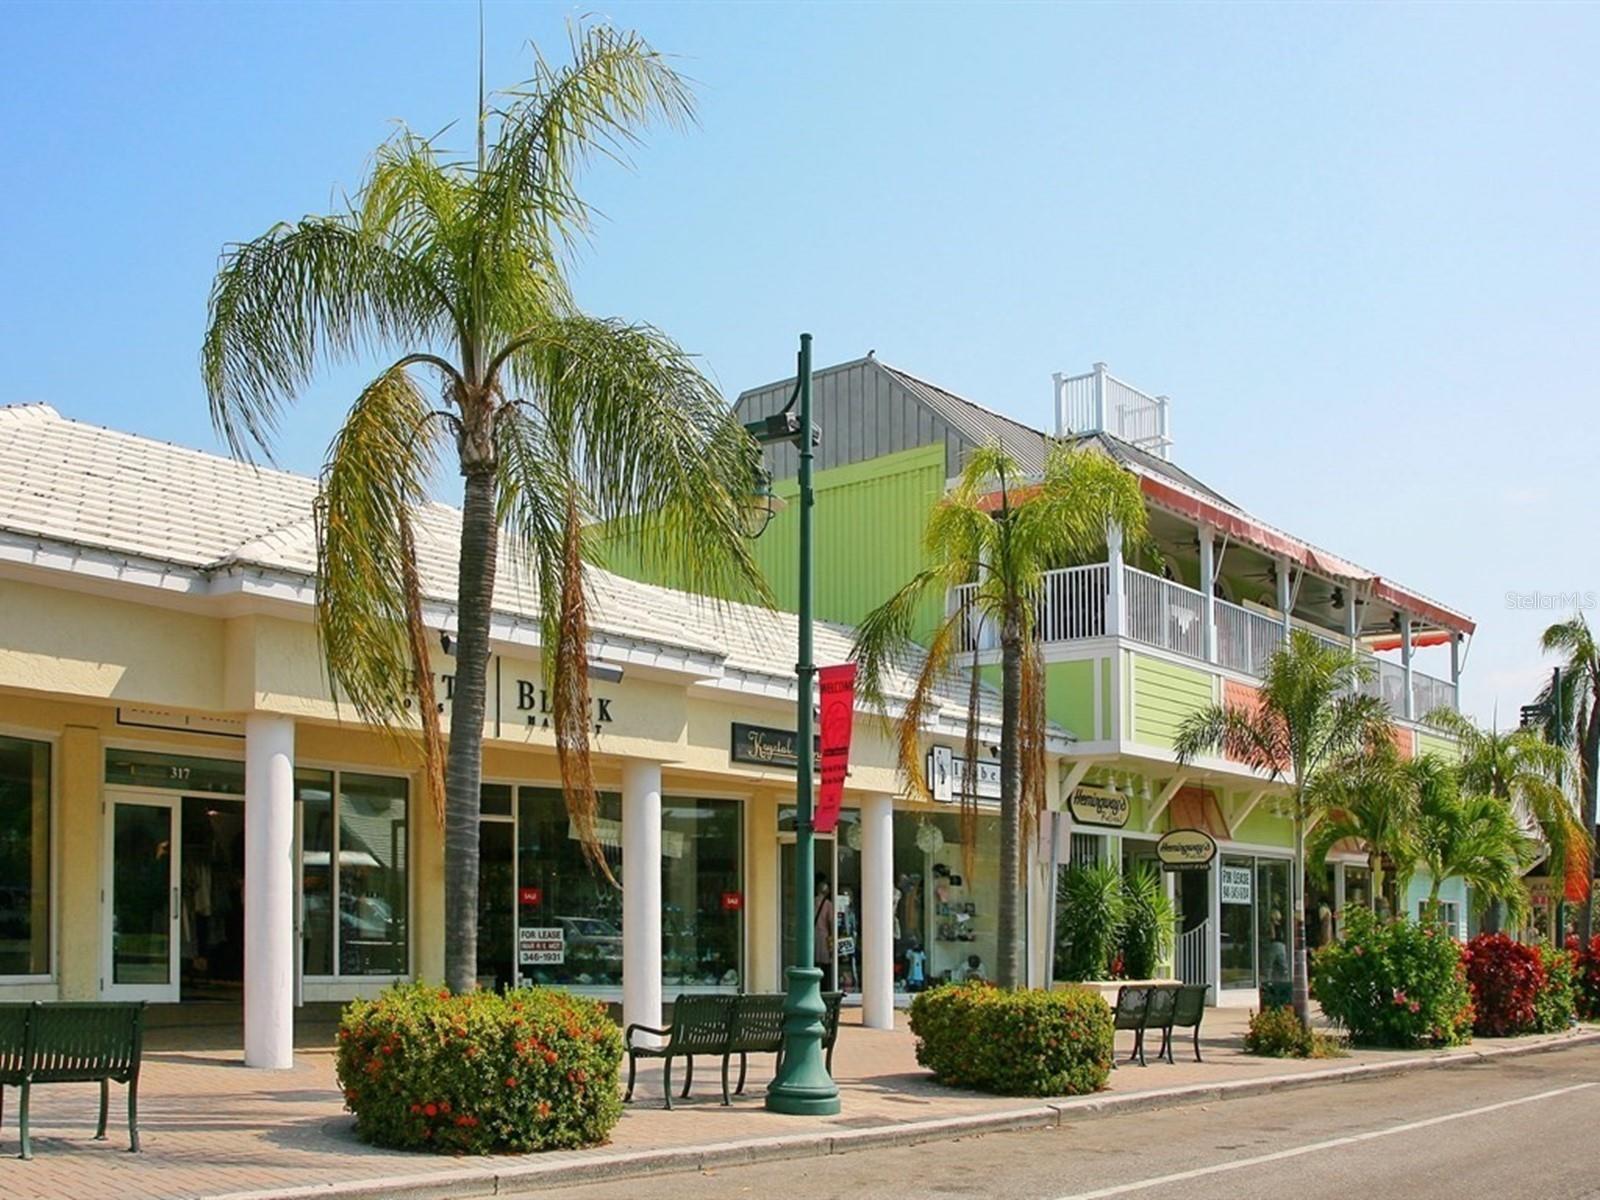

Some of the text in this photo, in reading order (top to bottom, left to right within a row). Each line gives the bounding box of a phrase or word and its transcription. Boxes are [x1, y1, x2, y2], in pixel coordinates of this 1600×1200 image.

[516, 680, 613, 722] BLK
[170, 767, 190, 779] 317
[521, 930, 561, 940] FOR LEASE
